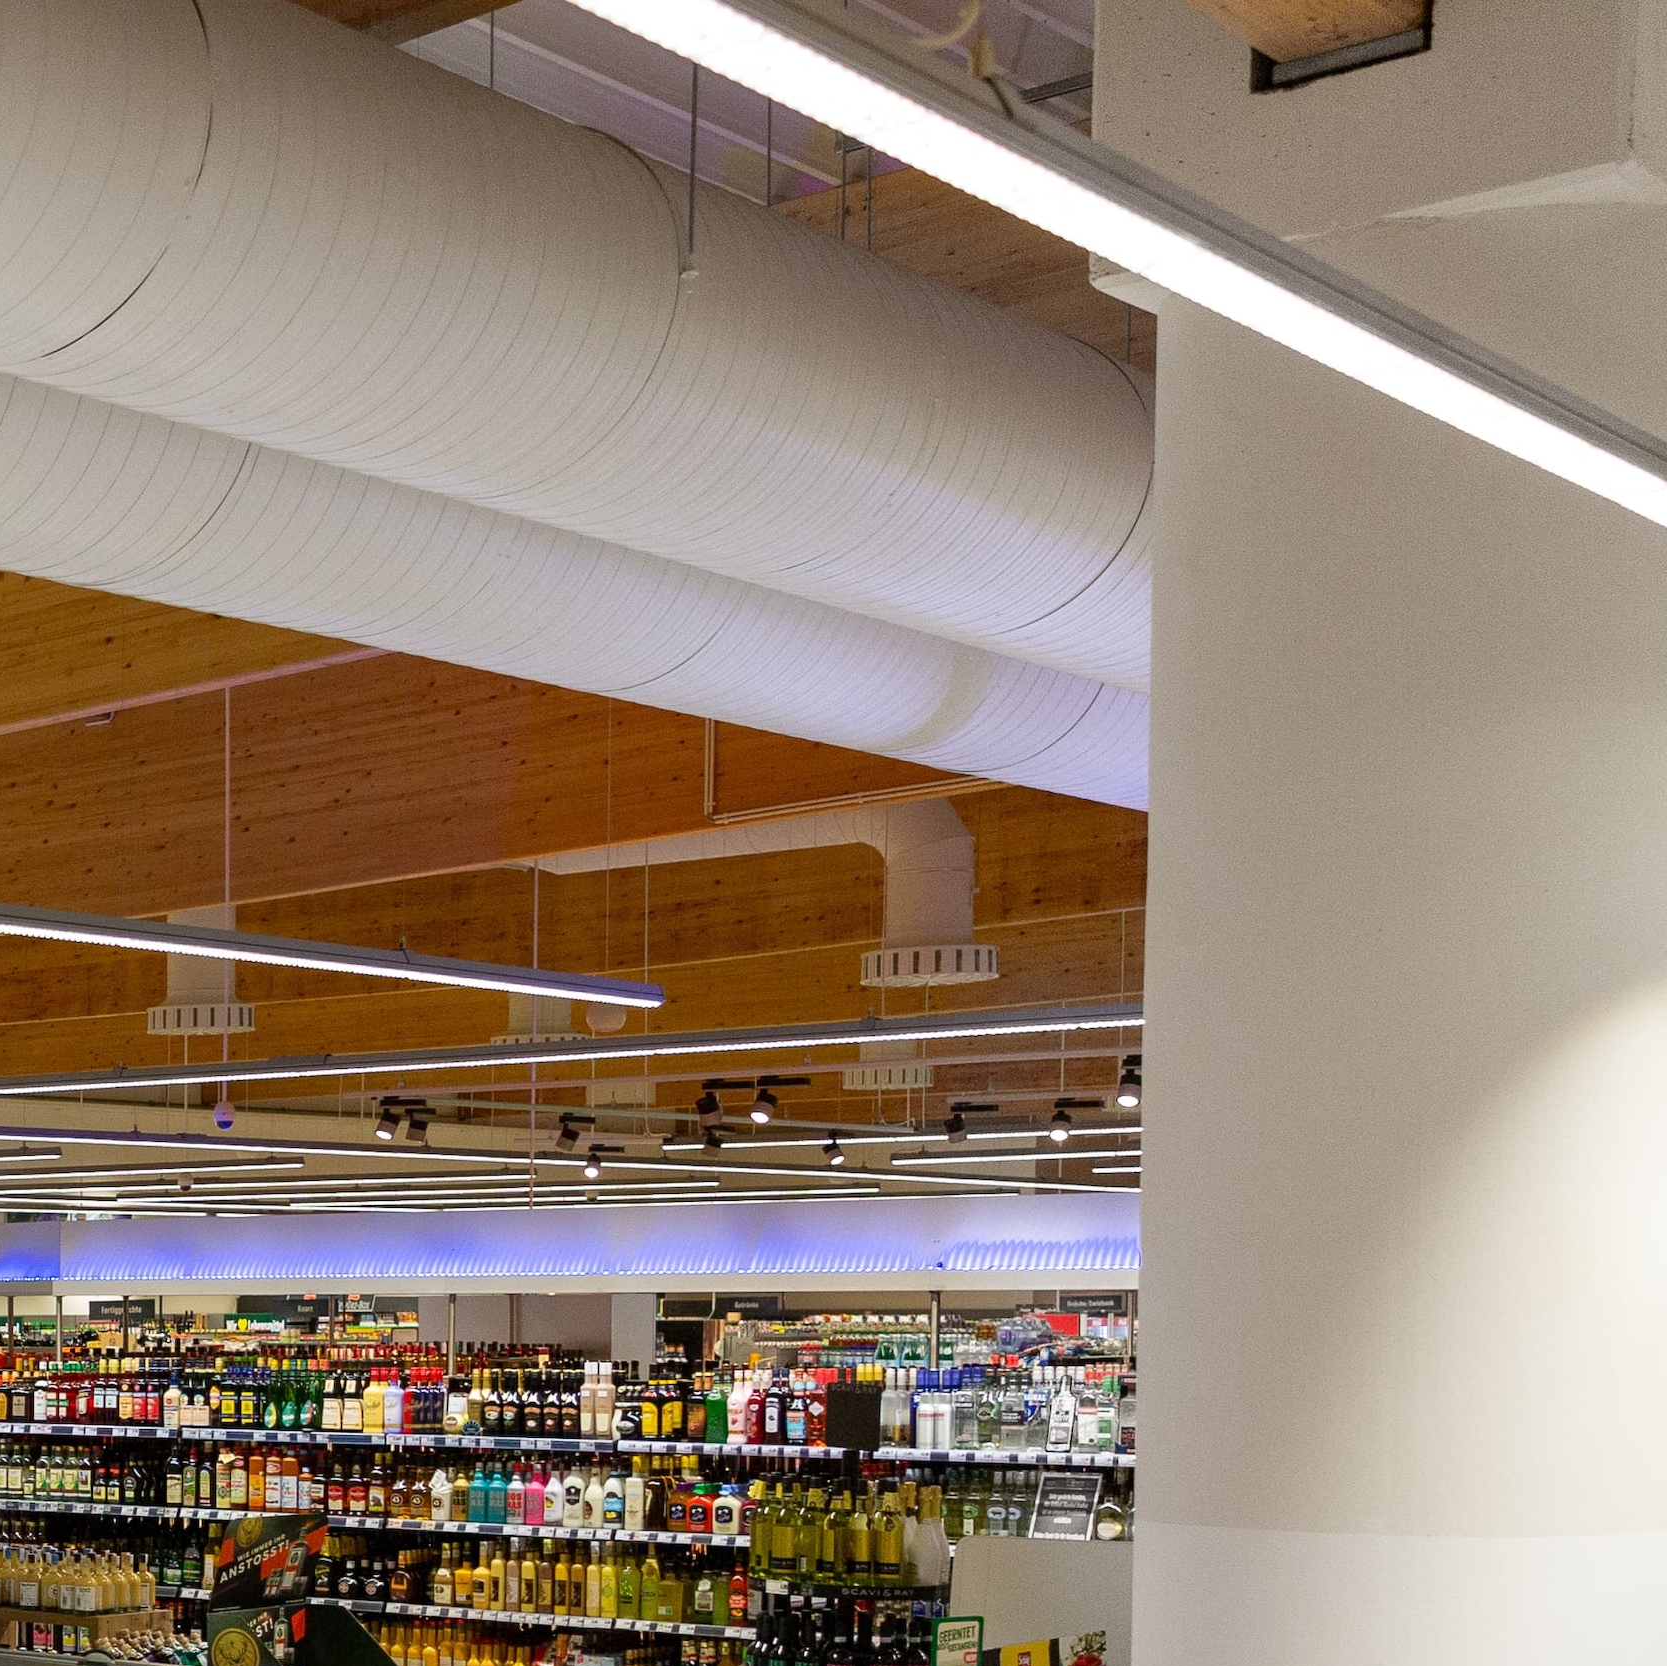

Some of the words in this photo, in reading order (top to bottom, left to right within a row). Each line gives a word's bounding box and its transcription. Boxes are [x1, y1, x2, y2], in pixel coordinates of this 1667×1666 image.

[237, 1549, 252, 1563] WIE
[253, 1539, 275, 1557] IMMER
[275, 1533, 287, 1545] IHR
[219, 1538, 291, 1585] ANSTOSST!
[841, 1587, 880, 1597] SCAVI
[882, 1586, 892, 1597] &
[894, 1587, 916, 1597] RAY
[938, 1625, 976, 1644] GEERNTET
